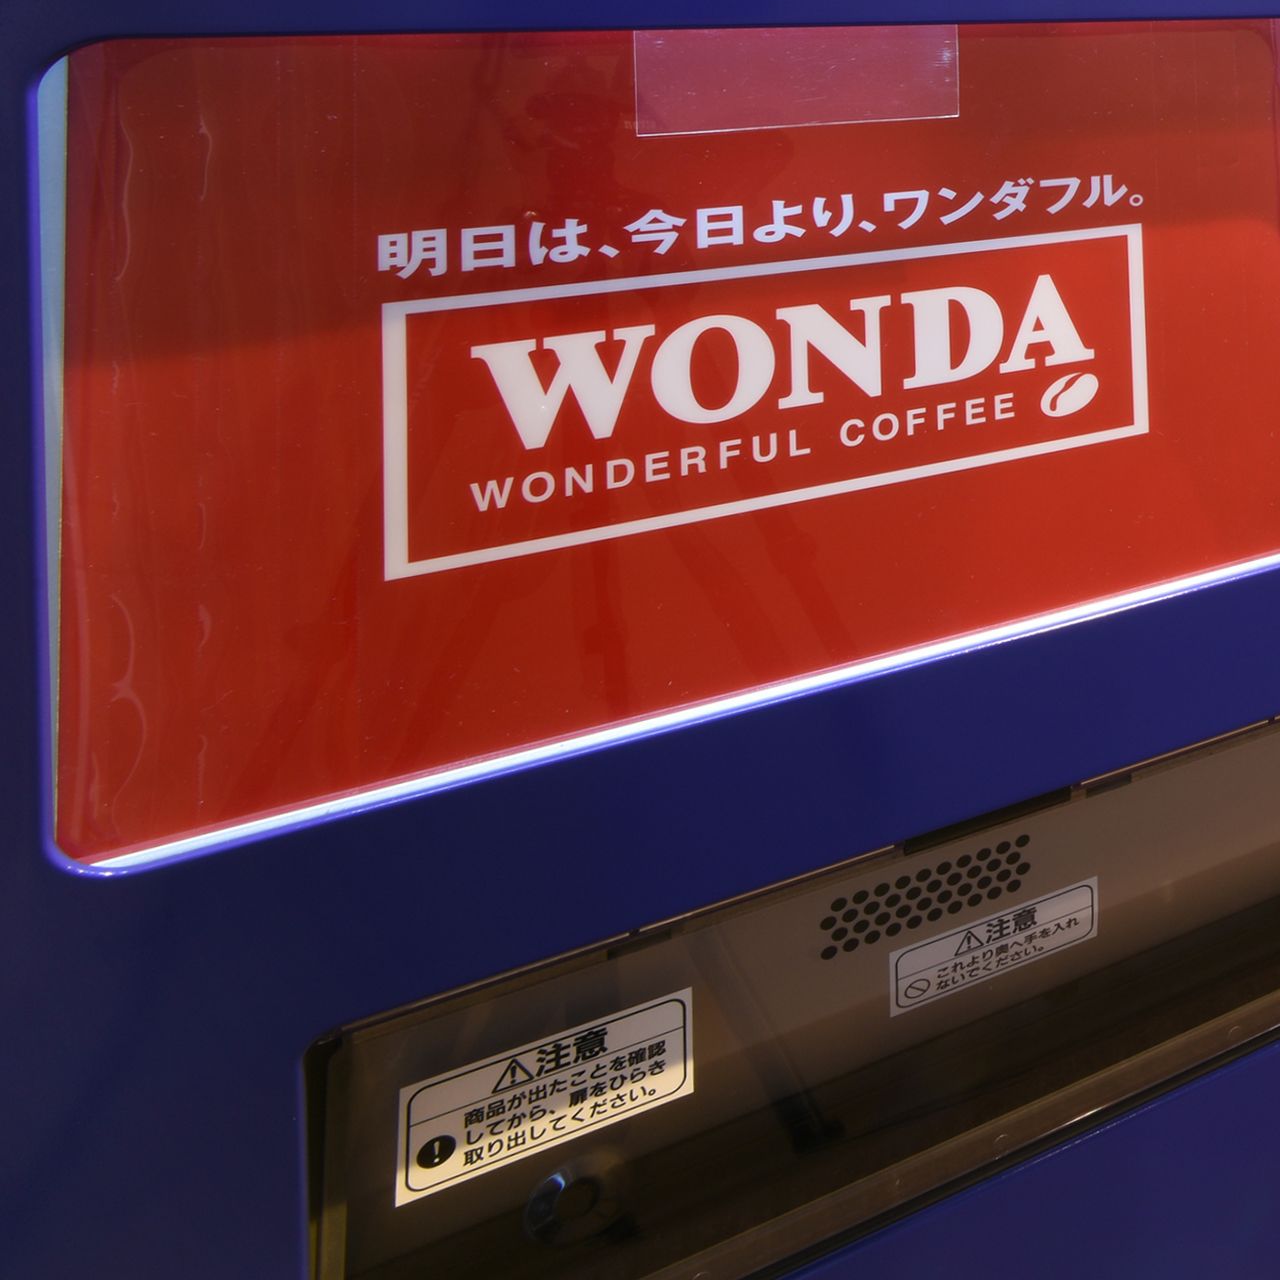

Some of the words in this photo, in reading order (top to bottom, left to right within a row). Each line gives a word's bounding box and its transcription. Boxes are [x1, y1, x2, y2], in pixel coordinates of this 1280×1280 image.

[376, 173, 1145, 279] 明日は、今日より、ワンダフル。
[470, 273, 1095, 452] WONDA
[470, 428, 812, 514] WONDERFUL
[839, 391, 1016, 448] COFFEE
[936, 916, 1081, 978] これより奥へ手を入れ
[986, 906, 1037, 944] 注意
[935, 945, 1045, 990] ないでください。
[464, 1039, 667, 1129] 商品が出たことを確認
[536, 1027, 608, 1077] 注意
[464, 1088, 658, 1167] 取り出してください。
[465, 1060, 666, 1145] してから、扉をひらき
